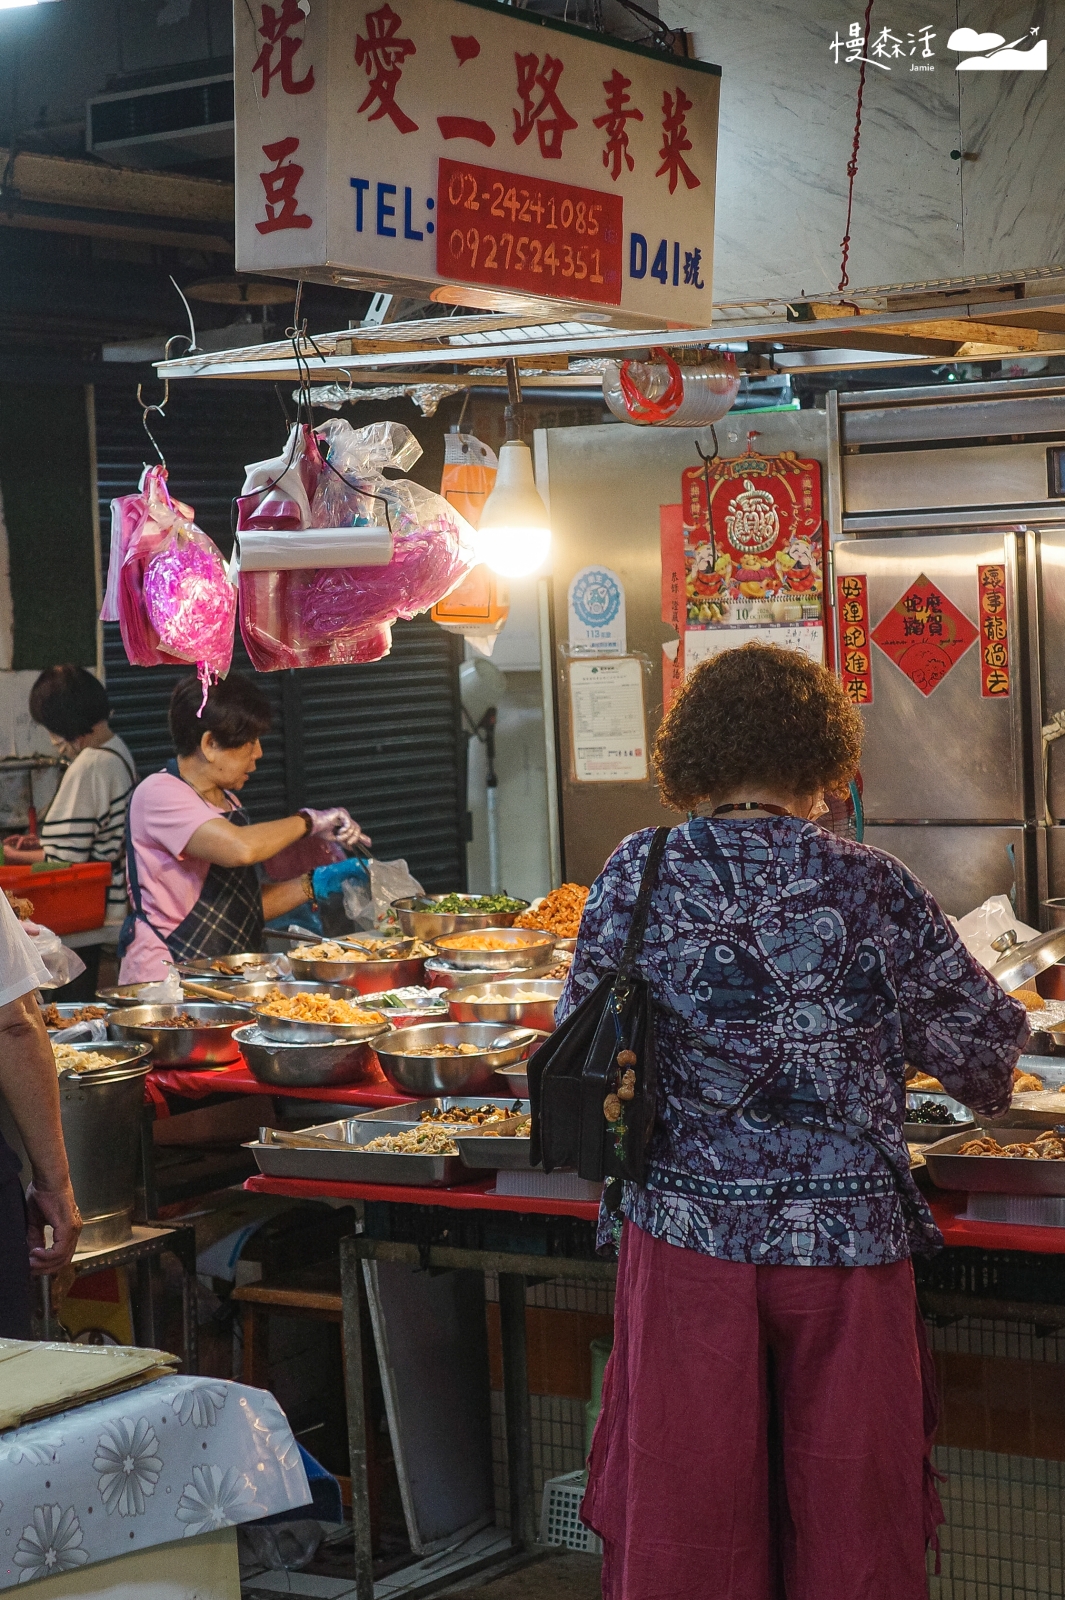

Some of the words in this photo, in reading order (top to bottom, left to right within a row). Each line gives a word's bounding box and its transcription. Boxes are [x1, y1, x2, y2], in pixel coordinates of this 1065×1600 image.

[251, 2, 316, 236] 花豆
[353, 2, 702, 196] 愛二路素菜
[349, 176, 436, 242] TEL:
[447, 171, 602, 237] 02-24241085
[448, 227, 605, 286] 0927524351
[736, 608, 749, 621] 10
[841, 577, 869, 703] 好運蛇進來
[982, 566, 1008, 694] 壞事龍過去
